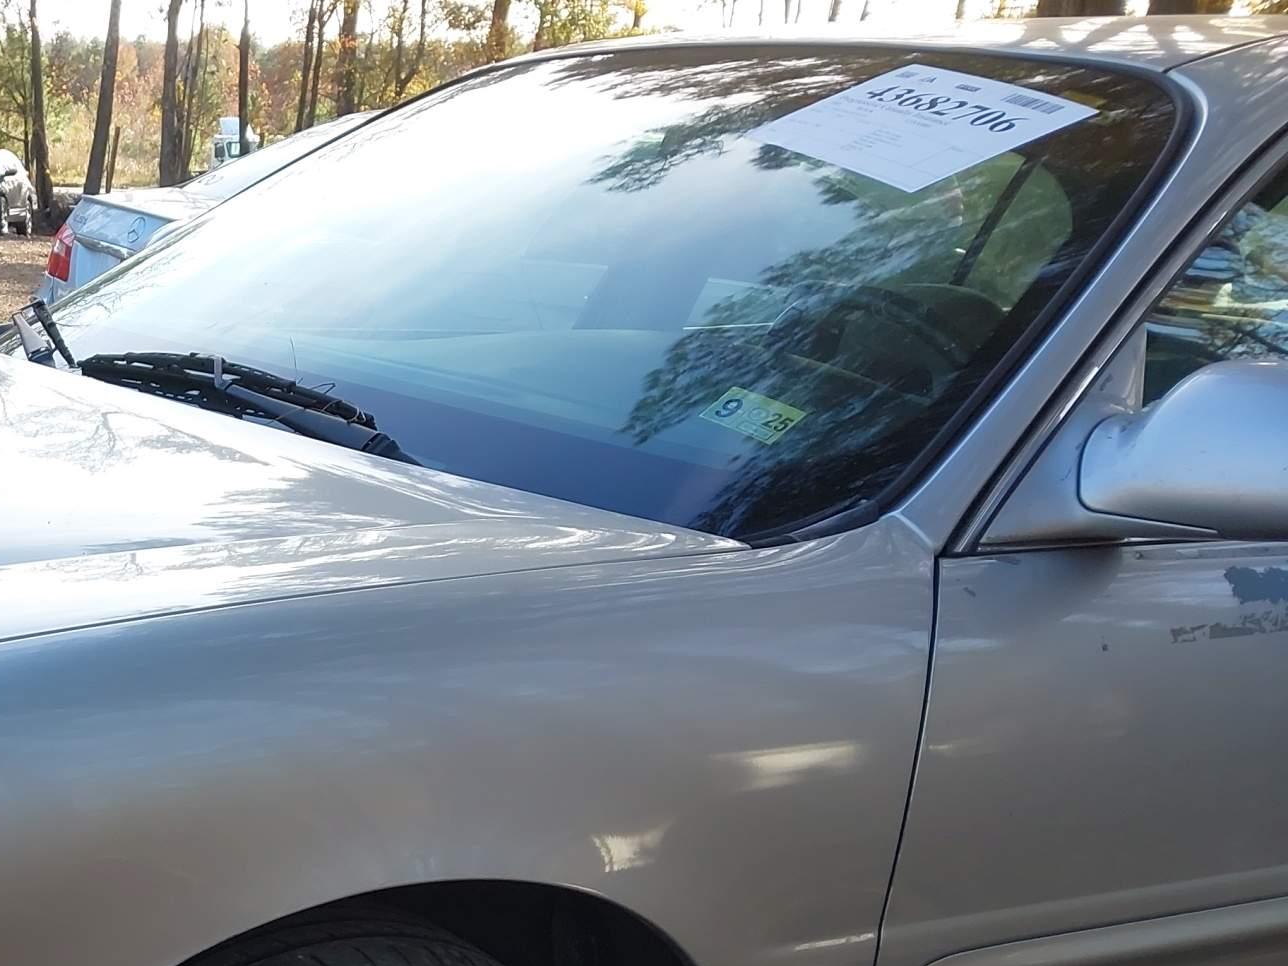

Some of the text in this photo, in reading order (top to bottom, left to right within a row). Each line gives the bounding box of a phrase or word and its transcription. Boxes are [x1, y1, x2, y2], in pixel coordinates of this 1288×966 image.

[867, 85, 1028, 132] 43682706
[715, 399, 743, 418] 9
[762, 413, 794, 432] 25
